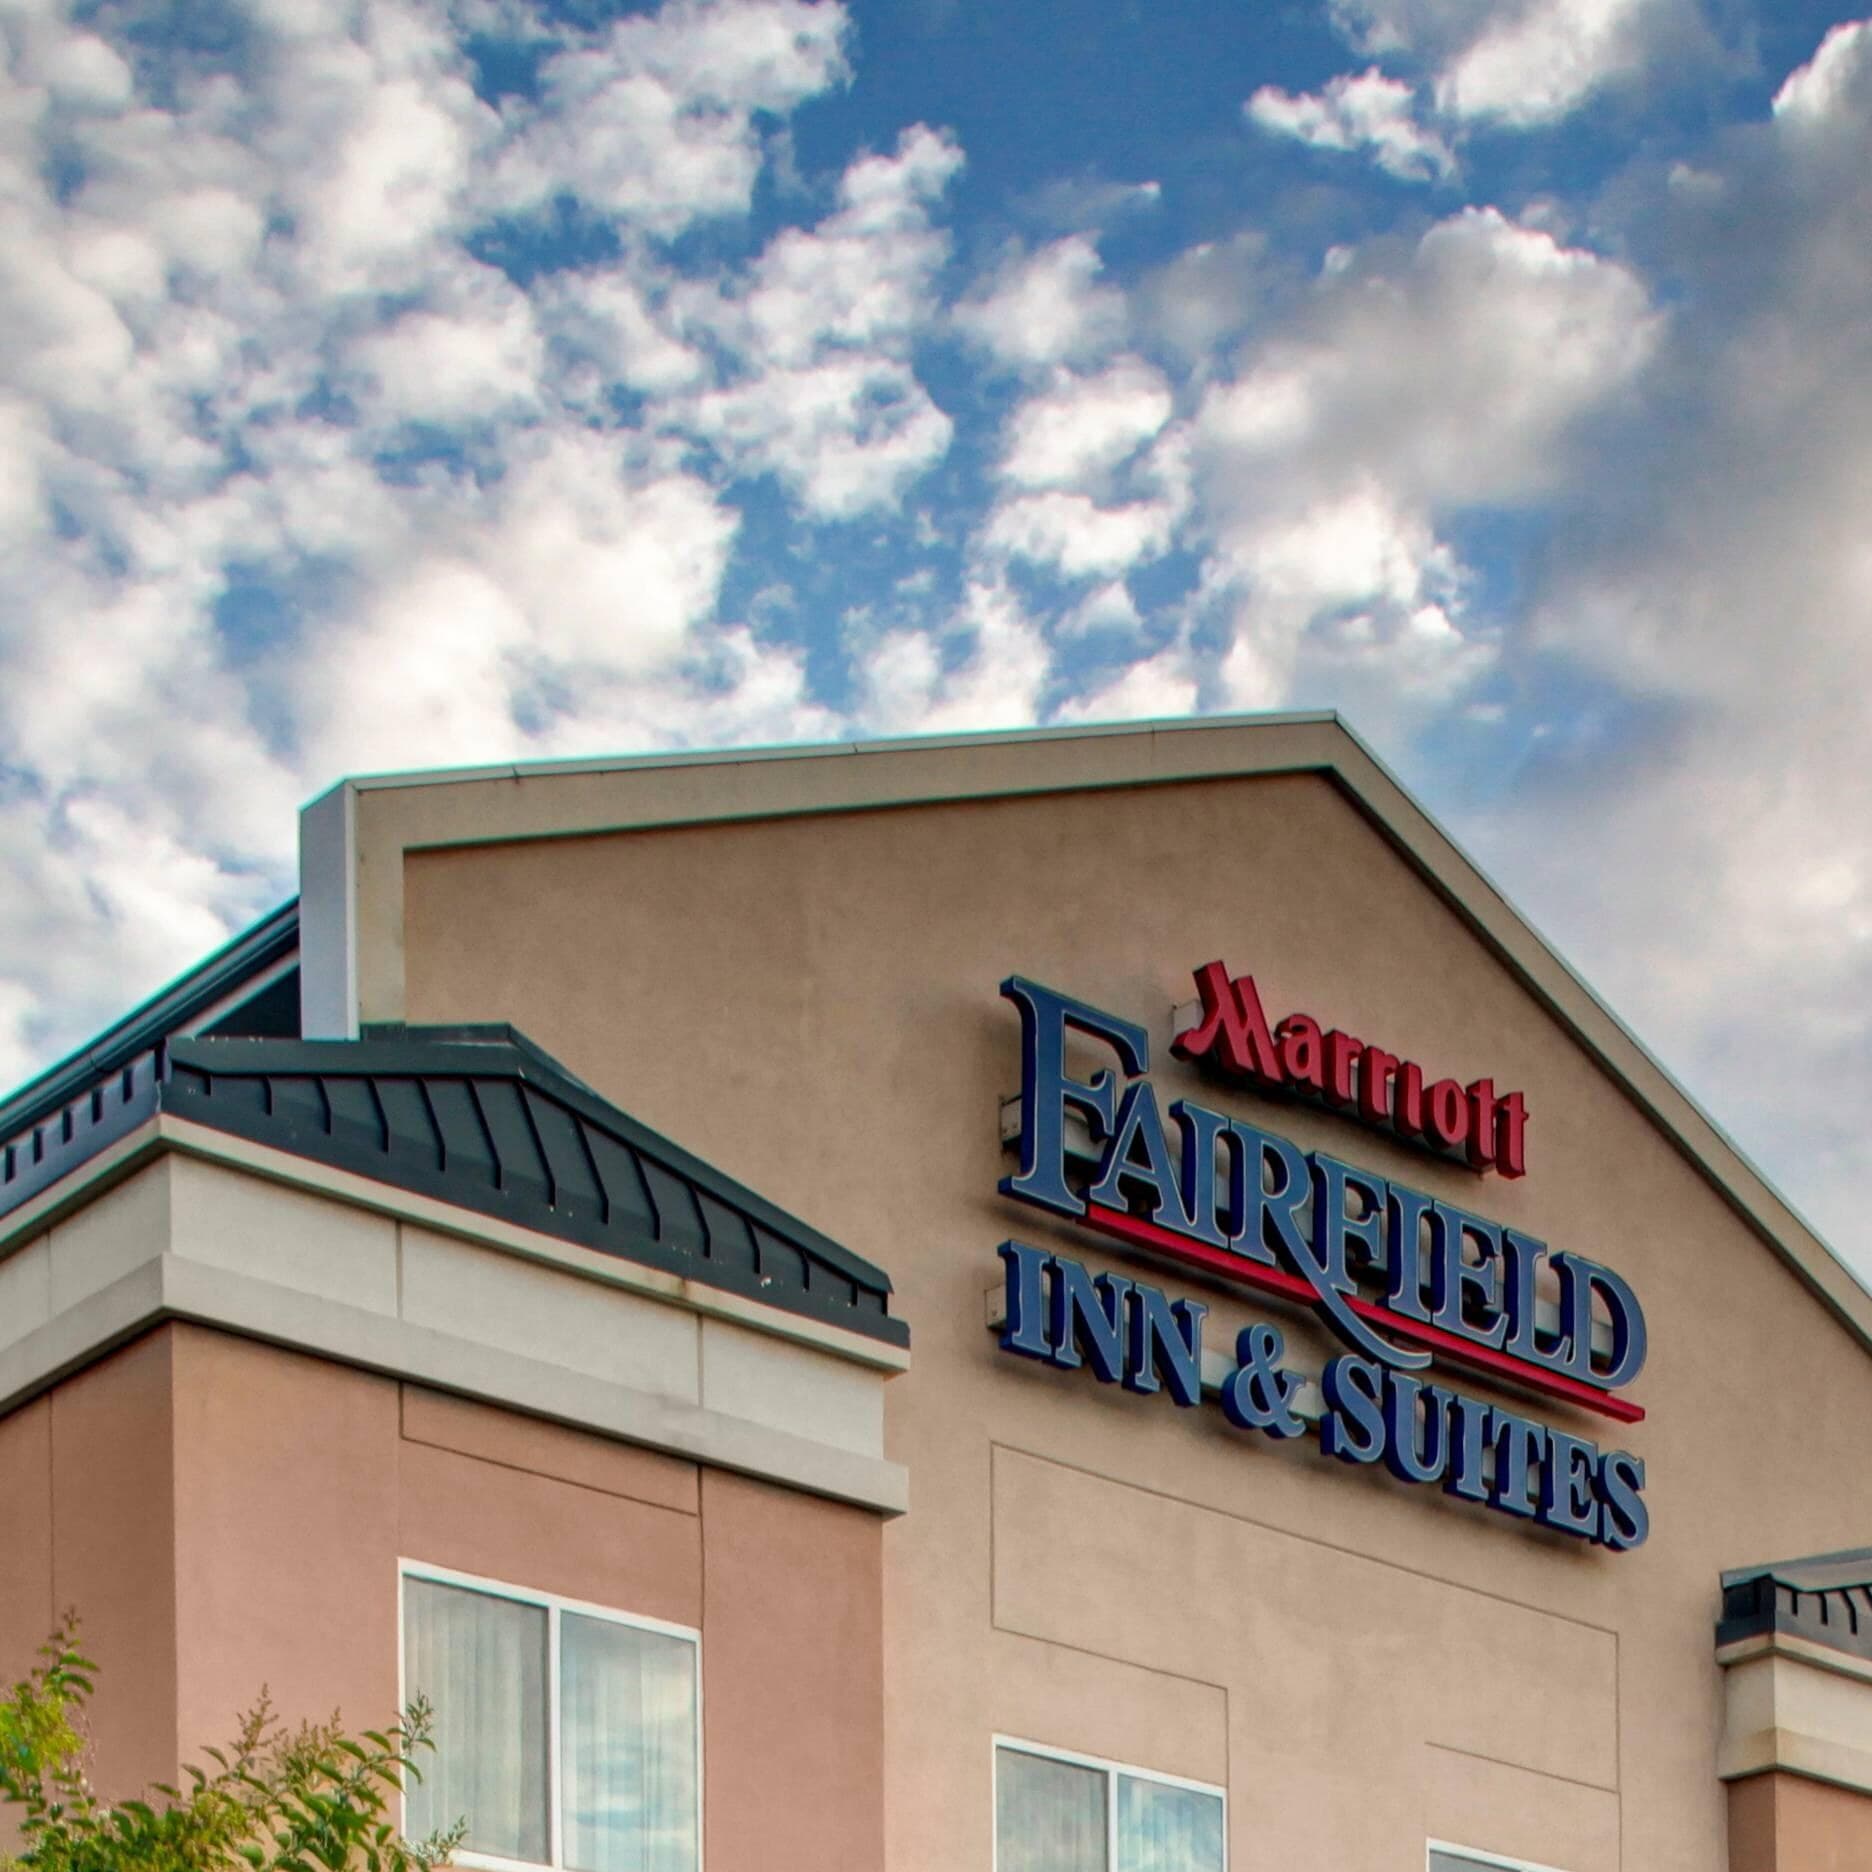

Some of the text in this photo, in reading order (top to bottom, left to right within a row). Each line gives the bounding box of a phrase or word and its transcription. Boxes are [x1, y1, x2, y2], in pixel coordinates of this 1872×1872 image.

[998, 975, 1648, 1390] FAIRFIELD
[1170, 960, 1530, 1179] Marriott
[998, 1240, 1650, 1553] INN & SUITES
